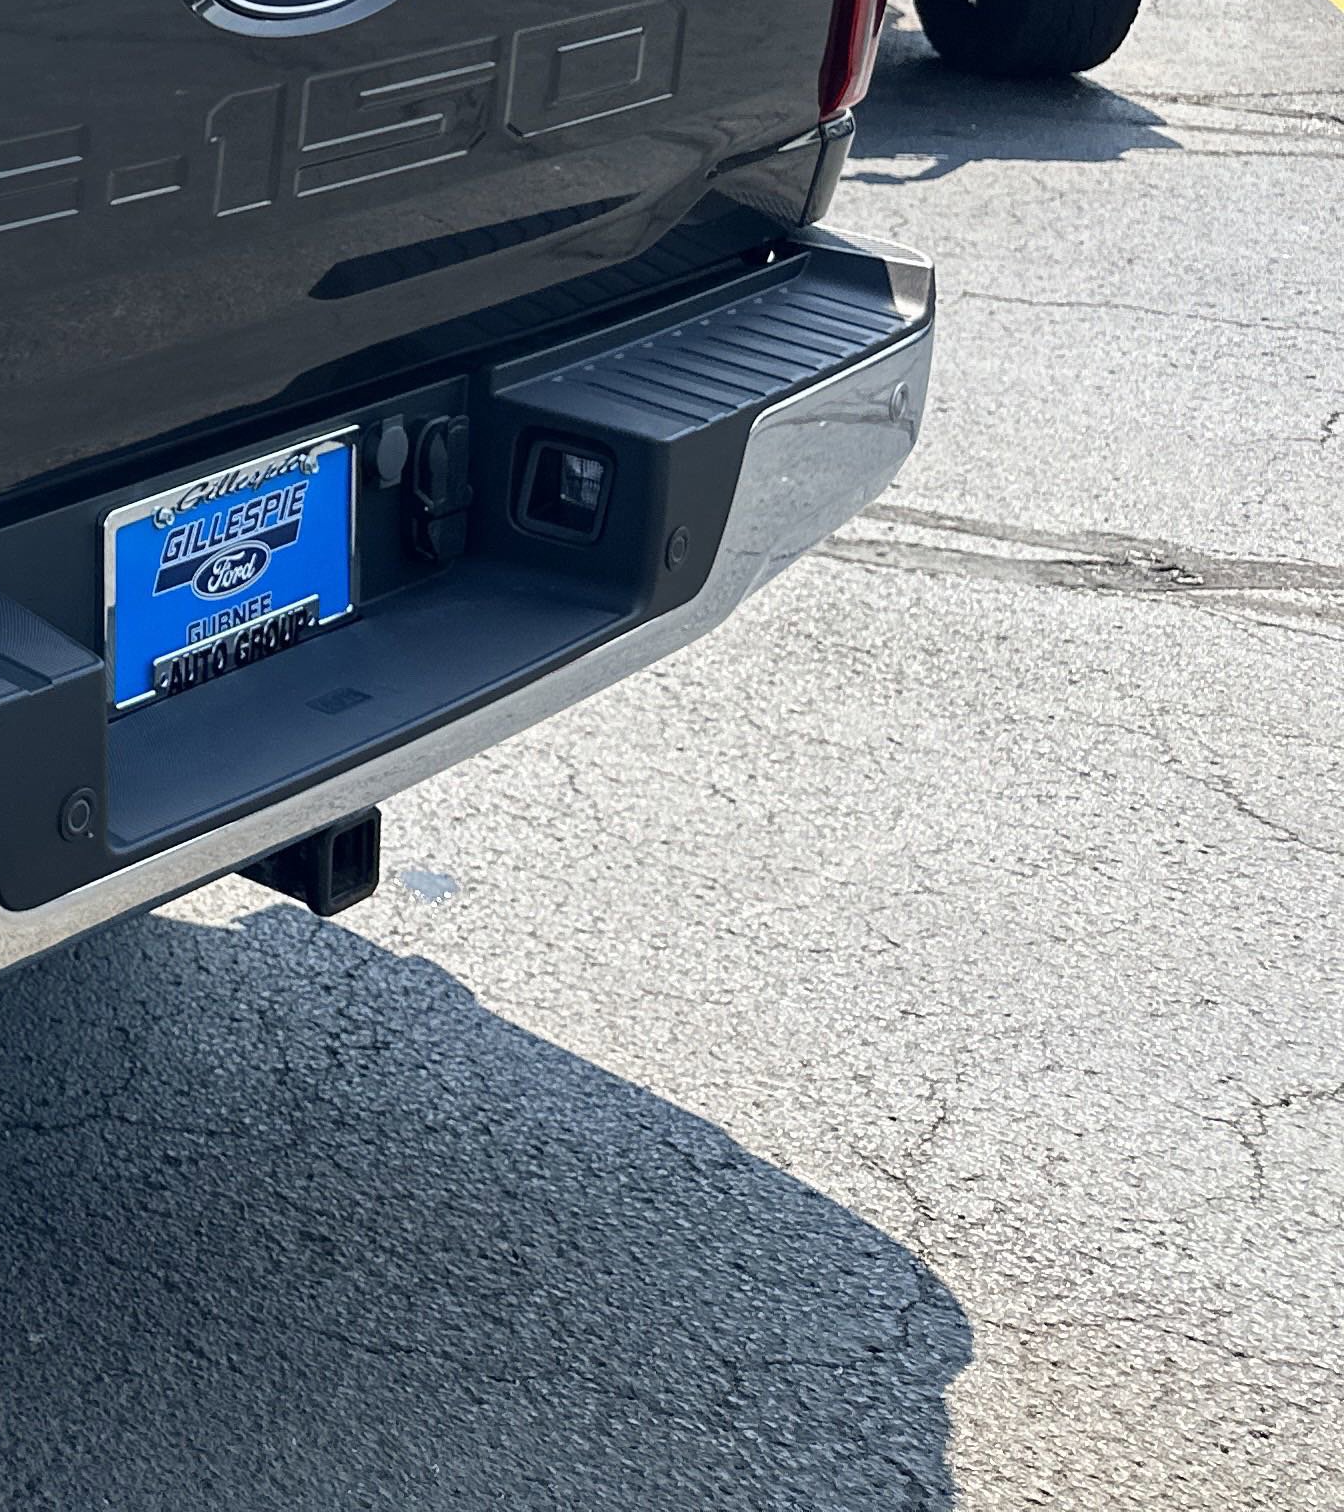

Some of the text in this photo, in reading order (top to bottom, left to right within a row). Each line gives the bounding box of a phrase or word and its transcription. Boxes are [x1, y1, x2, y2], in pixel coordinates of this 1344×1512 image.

[161, 480, 310, 565] GILLESPIE
[206, 549, 257, 592] Ford
[167, 605, 308, 696] AUTO GROUP
[186, 591, 273, 646] GURNEE
